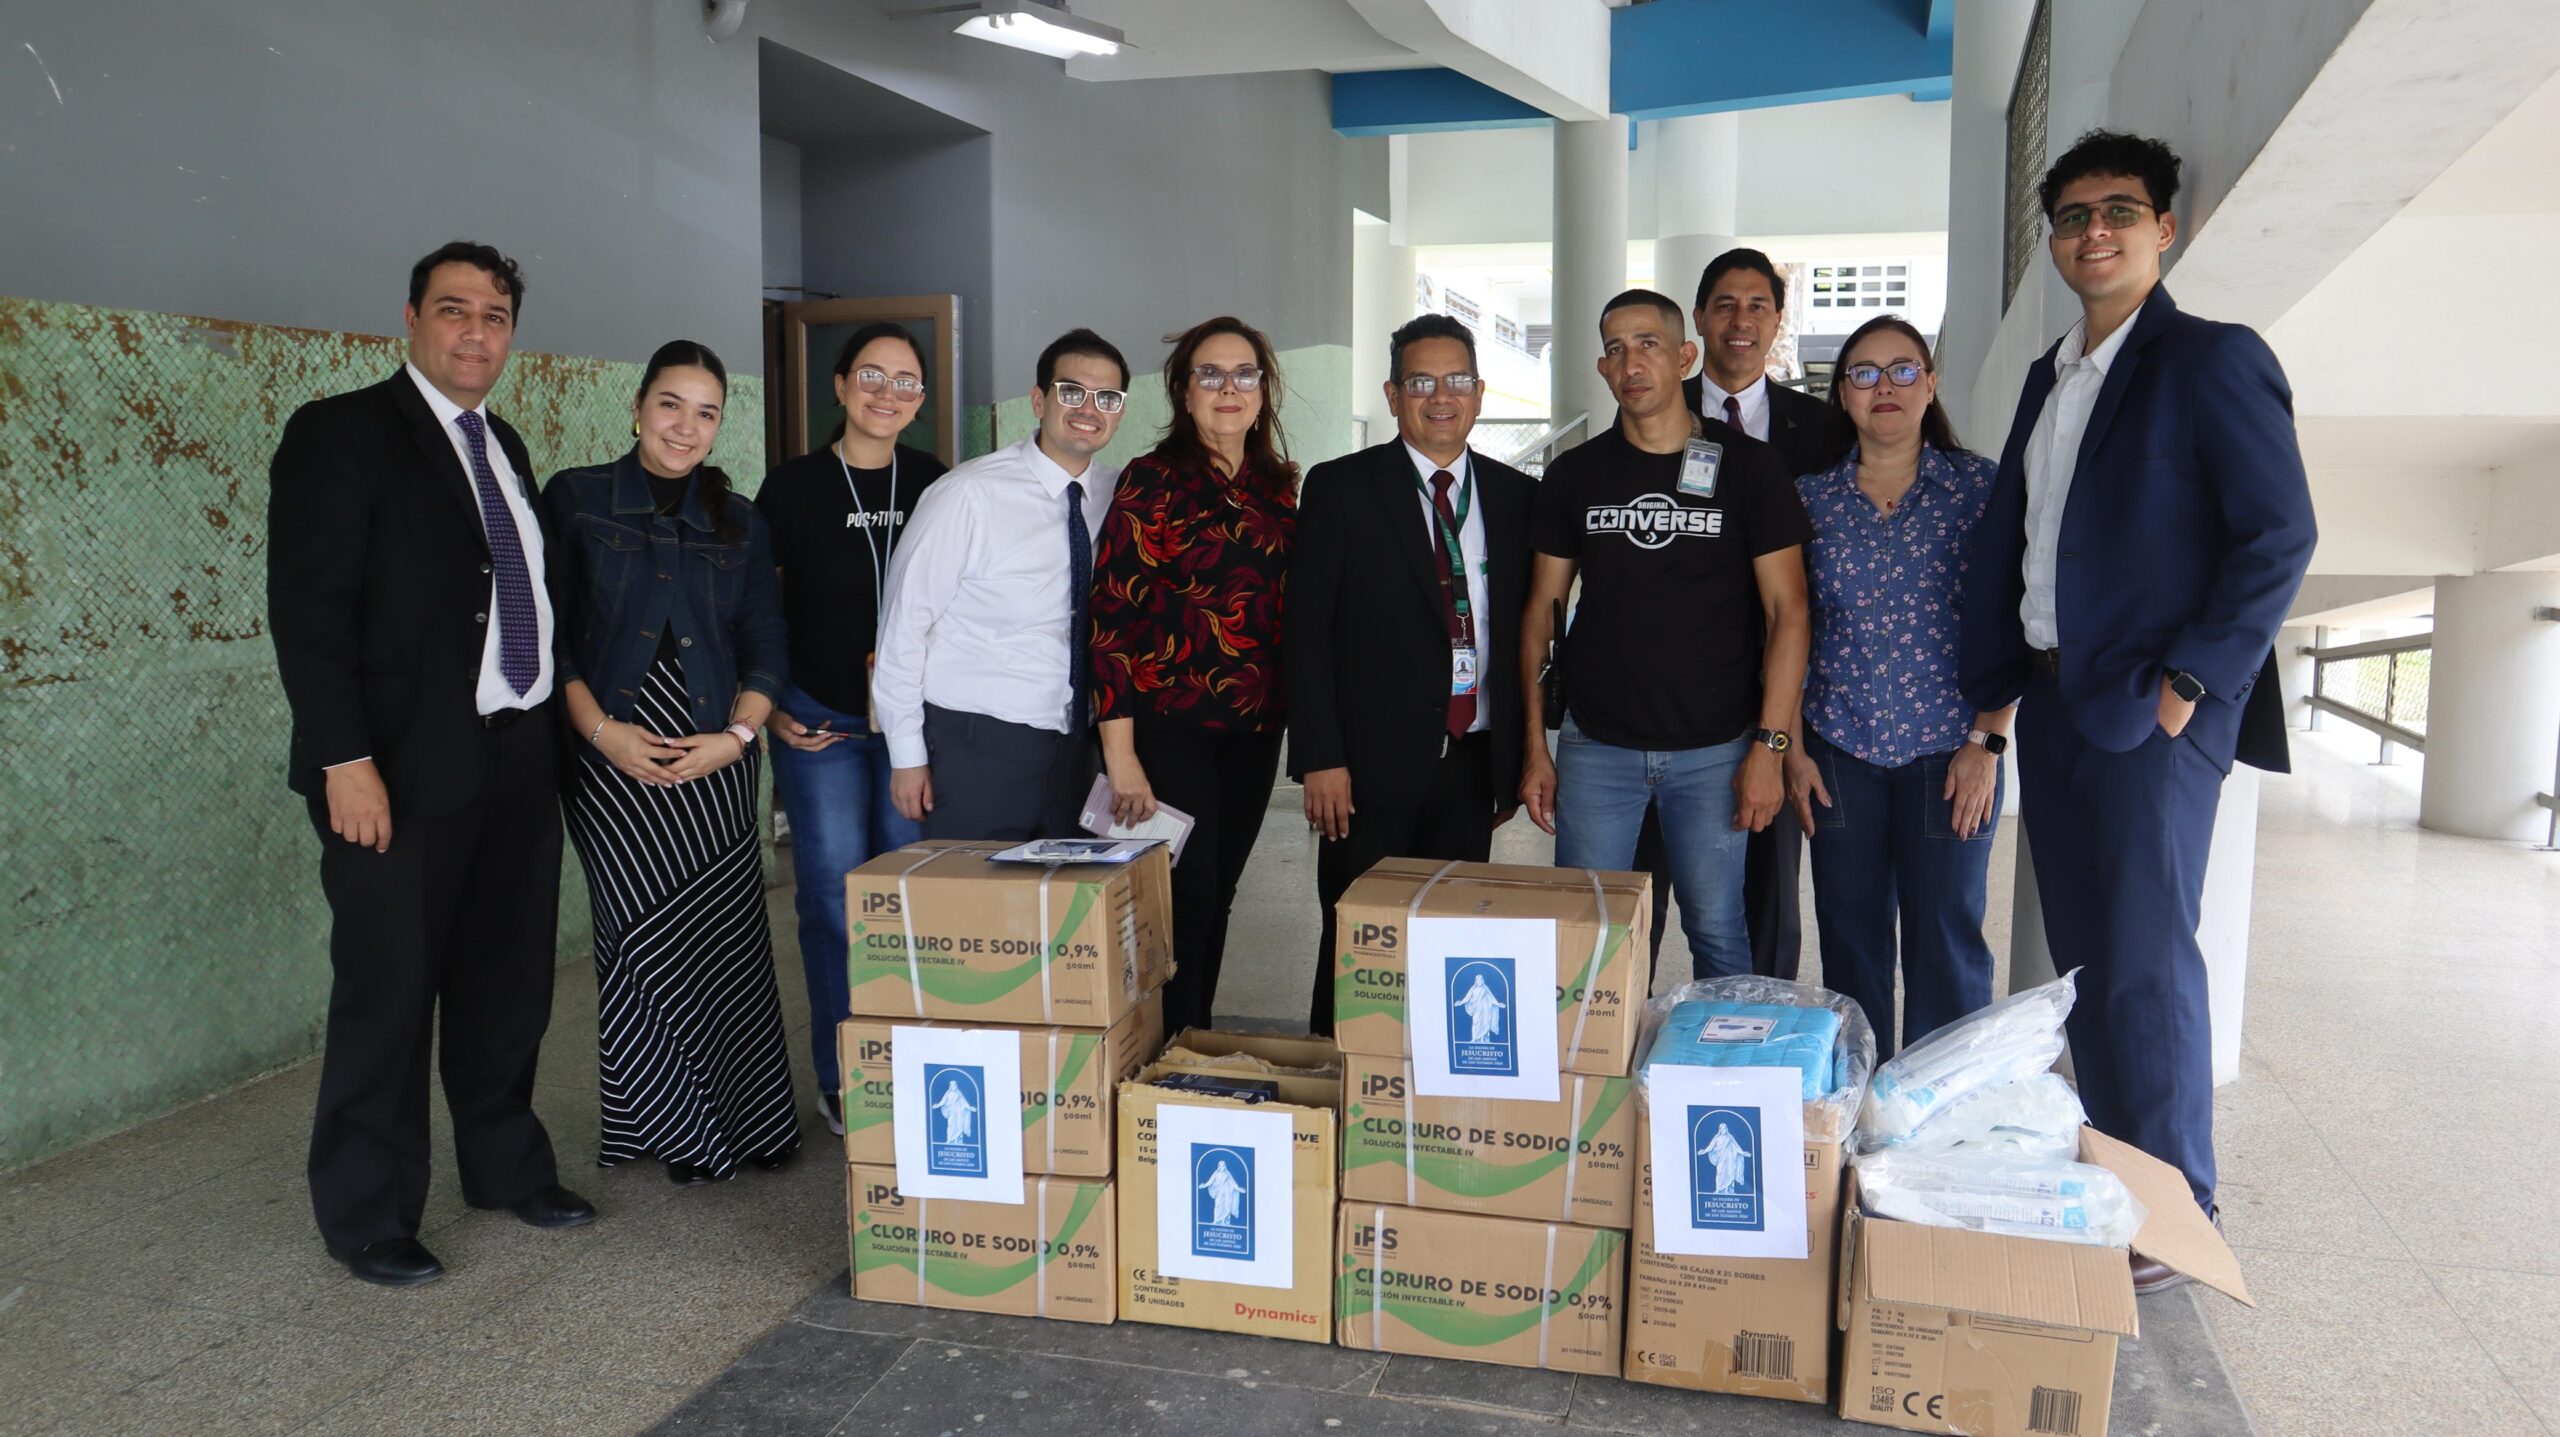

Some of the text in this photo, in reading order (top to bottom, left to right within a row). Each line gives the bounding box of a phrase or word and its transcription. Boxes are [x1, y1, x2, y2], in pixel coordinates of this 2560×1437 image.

[1637, 502, 1669, 510] ORIGINAL
[1586, 509, 1723, 534] CONVERSE
[1353, 922, 1398, 949] iPS
[960, 938, 984, 953] DE
[908, 957, 955, 966] YECTABLE
[1066, 962, 1095, 970] 500ml
[1355, 968, 1406, 988] CLOR
[1461, 1050, 1504, 1058] JESUCRISTO
[1362, 1073, 1406, 1098] iPS
[864, 1100, 894, 1110] SOLUCI
[1063, 1112, 1092, 1120] 500ml
[1138, 1118, 1157, 1128] VE
[1469, 1128, 1496, 1145] DE
[1503, 1132, 1570, 1152] SODIO
[1408, 1143, 1462, 1156] NYECTABLE
[1587, 1161, 1620, 1170] 500ml
[1704, 1201, 1749, 1210] JESUCRISTO
[962, 1233, 986, 1248] DE
[912, 1247, 958, 1259] INECTABLE
[1067, 1261, 1096, 1270] 500ml
[1460, 1280, 1487, 1296] DE
[1494, 1283, 1561, 1305] SODIO
[1134, 1294, 1185, 1308] 36 UNIDADES
[1235, 1303, 1318, 1325] Dynamics
[1578, 1312, 1608, 1321] 500ml
[1741, 1329, 1789, 1341] Dynamics
[1872, 1385, 1895, 1395] ISO
